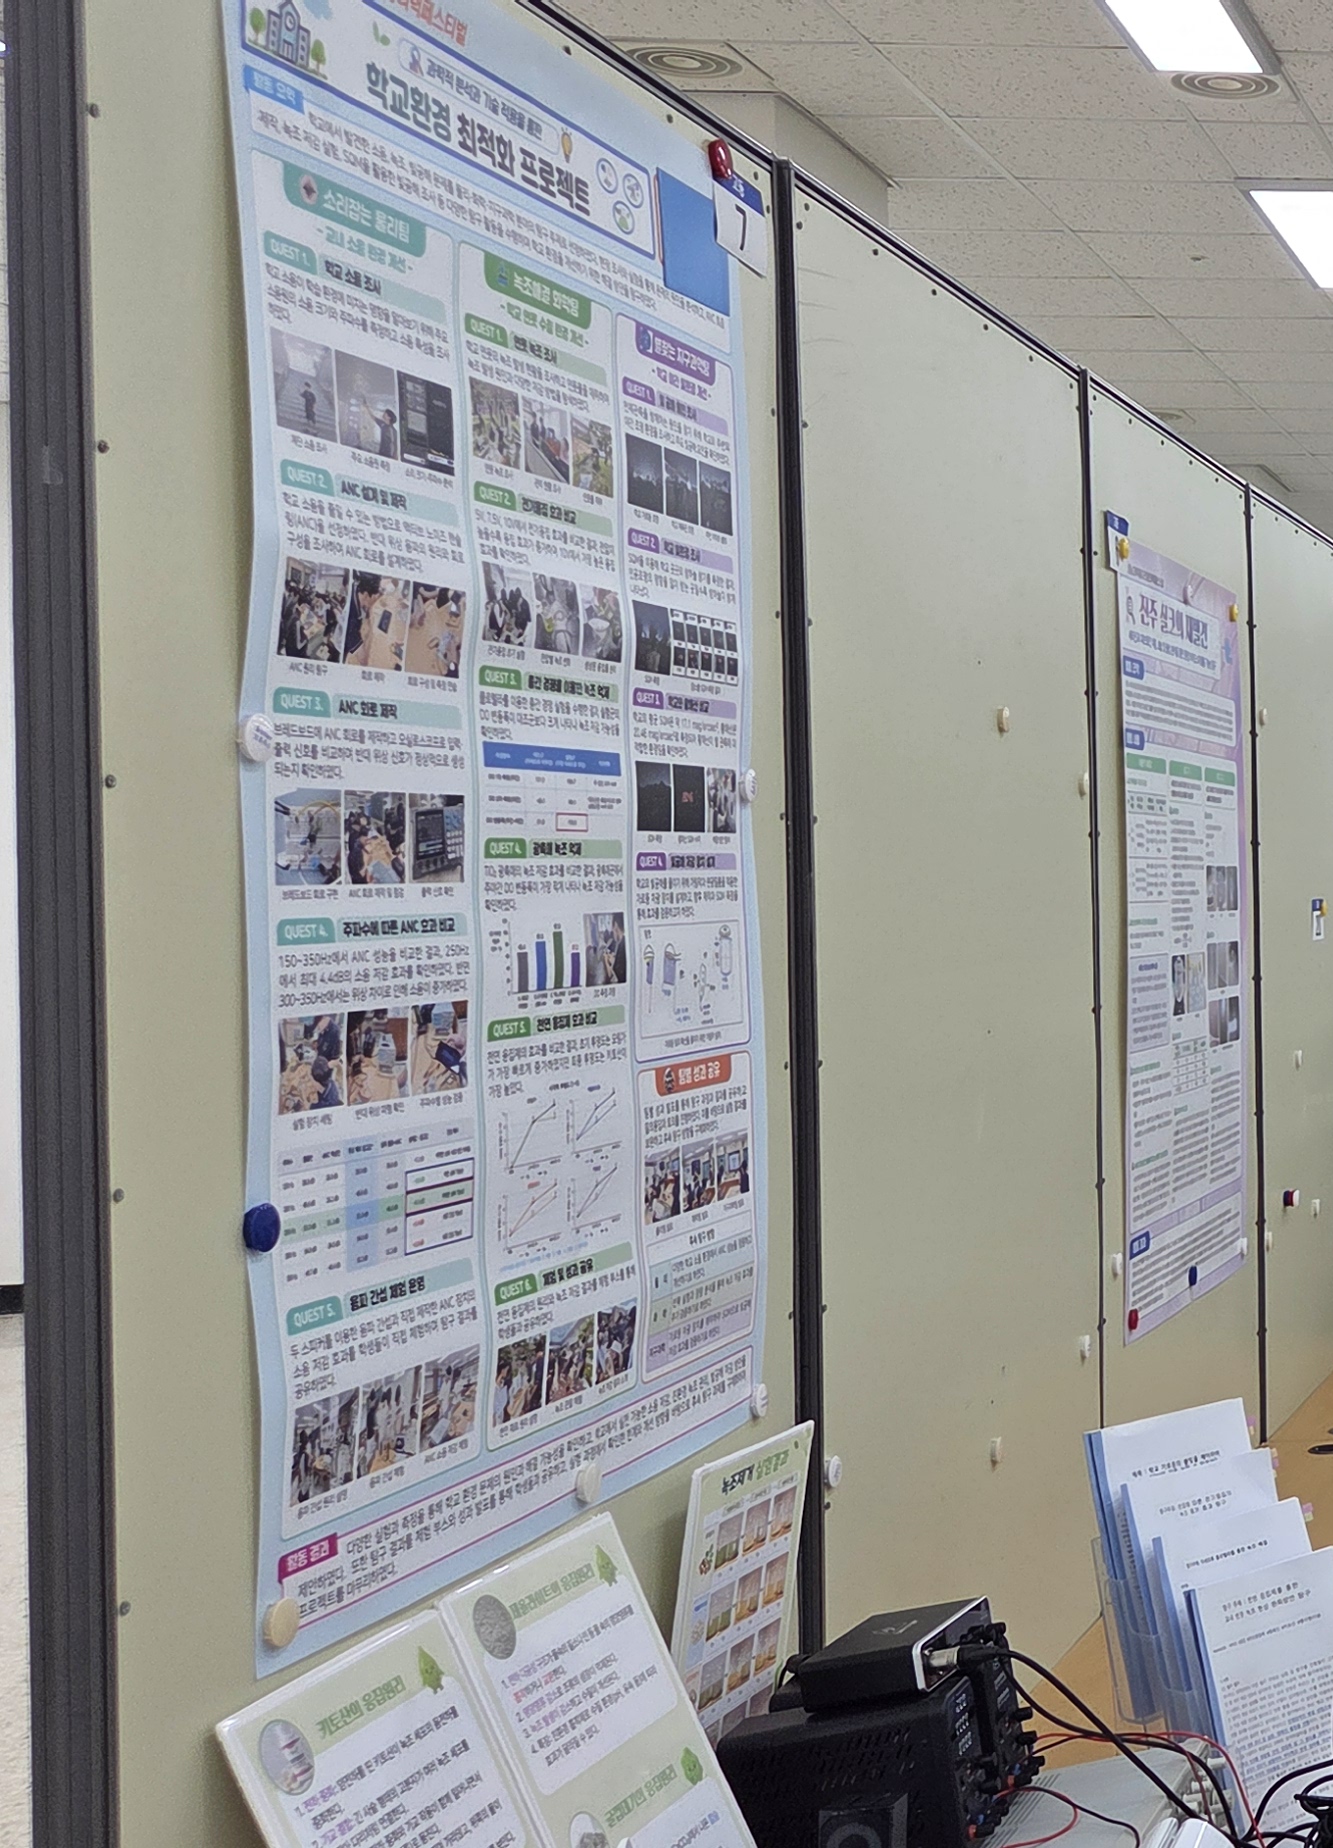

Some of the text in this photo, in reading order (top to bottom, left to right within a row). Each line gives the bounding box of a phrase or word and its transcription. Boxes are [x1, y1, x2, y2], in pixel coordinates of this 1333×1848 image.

[366, 61, 591, 217] 학교환경 최적화 프로젝트
[735, 204, 747, 251] 7
[287, 466, 316, 485] QUEST
[1140, 594, 1157, 629] 진주
[280, 694, 312, 709] QUEST
[339, 700, 359, 714] ANC
[324, 729, 341, 741] ANC
[284, 923, 317, 938] QUEST
[343, 921, 379, 937] 주파수에
[381, 920, 399, 936] 따른
[400, 920, 419, 934] ANC
[351, 950, 370, 963] ANC
[493, 1023, 518, 1037] QUEST
[350, 1294, 369, 1312] 음파
[408, 1275, 425, 1294] 운영
[500, 1281, 524, 1299] QUEST
[294, 1305, 325, 1327] QUEST
[315, 1674, 406, 1739] 키토산의 응집원리
